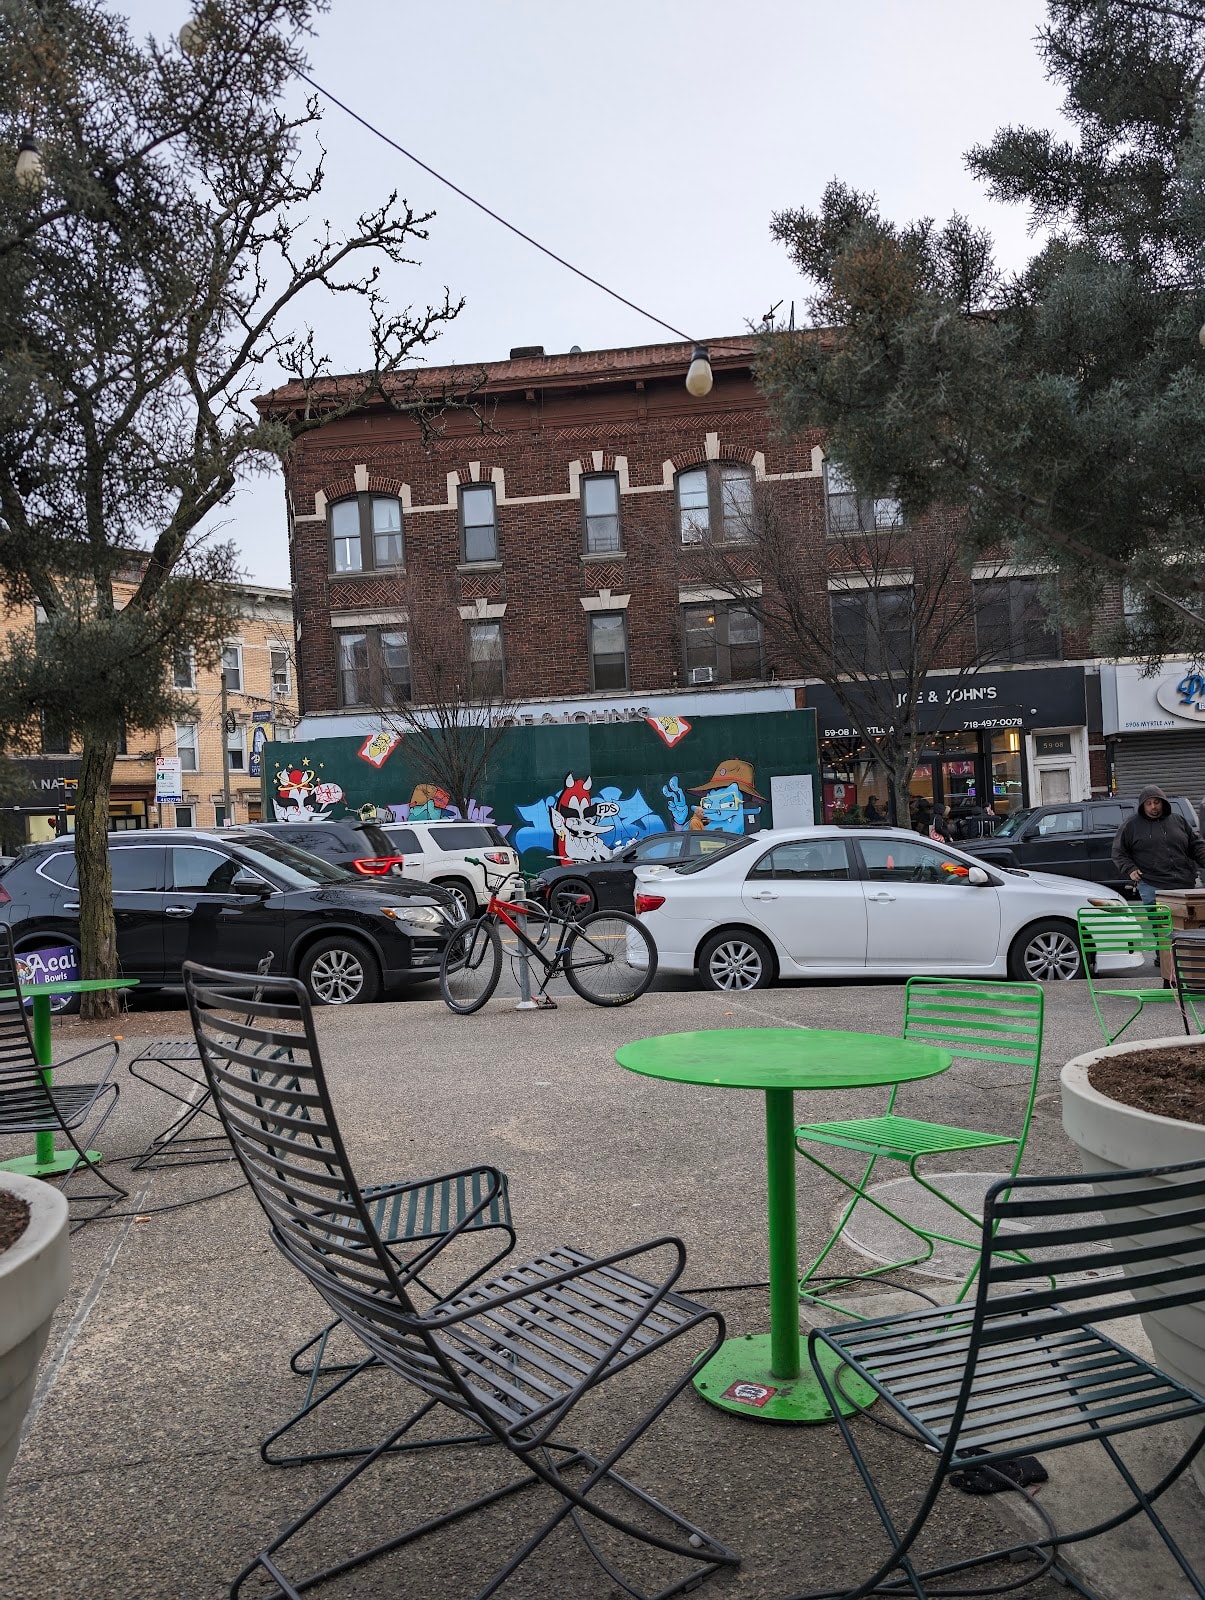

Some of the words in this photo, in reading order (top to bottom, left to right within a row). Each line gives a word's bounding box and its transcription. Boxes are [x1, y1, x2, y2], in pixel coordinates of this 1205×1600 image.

[928, 691, 939, 703] &
[945, 686, 997, 705] JOHN'S
[963, 718, 1023, 729] 718-497-0078
[824, 728, 850, 737] 59-08
[599, 803, 618, 814] FDS
[26, 948, 77, 980] Acai
[44, 971, 68, 983] Bowls
